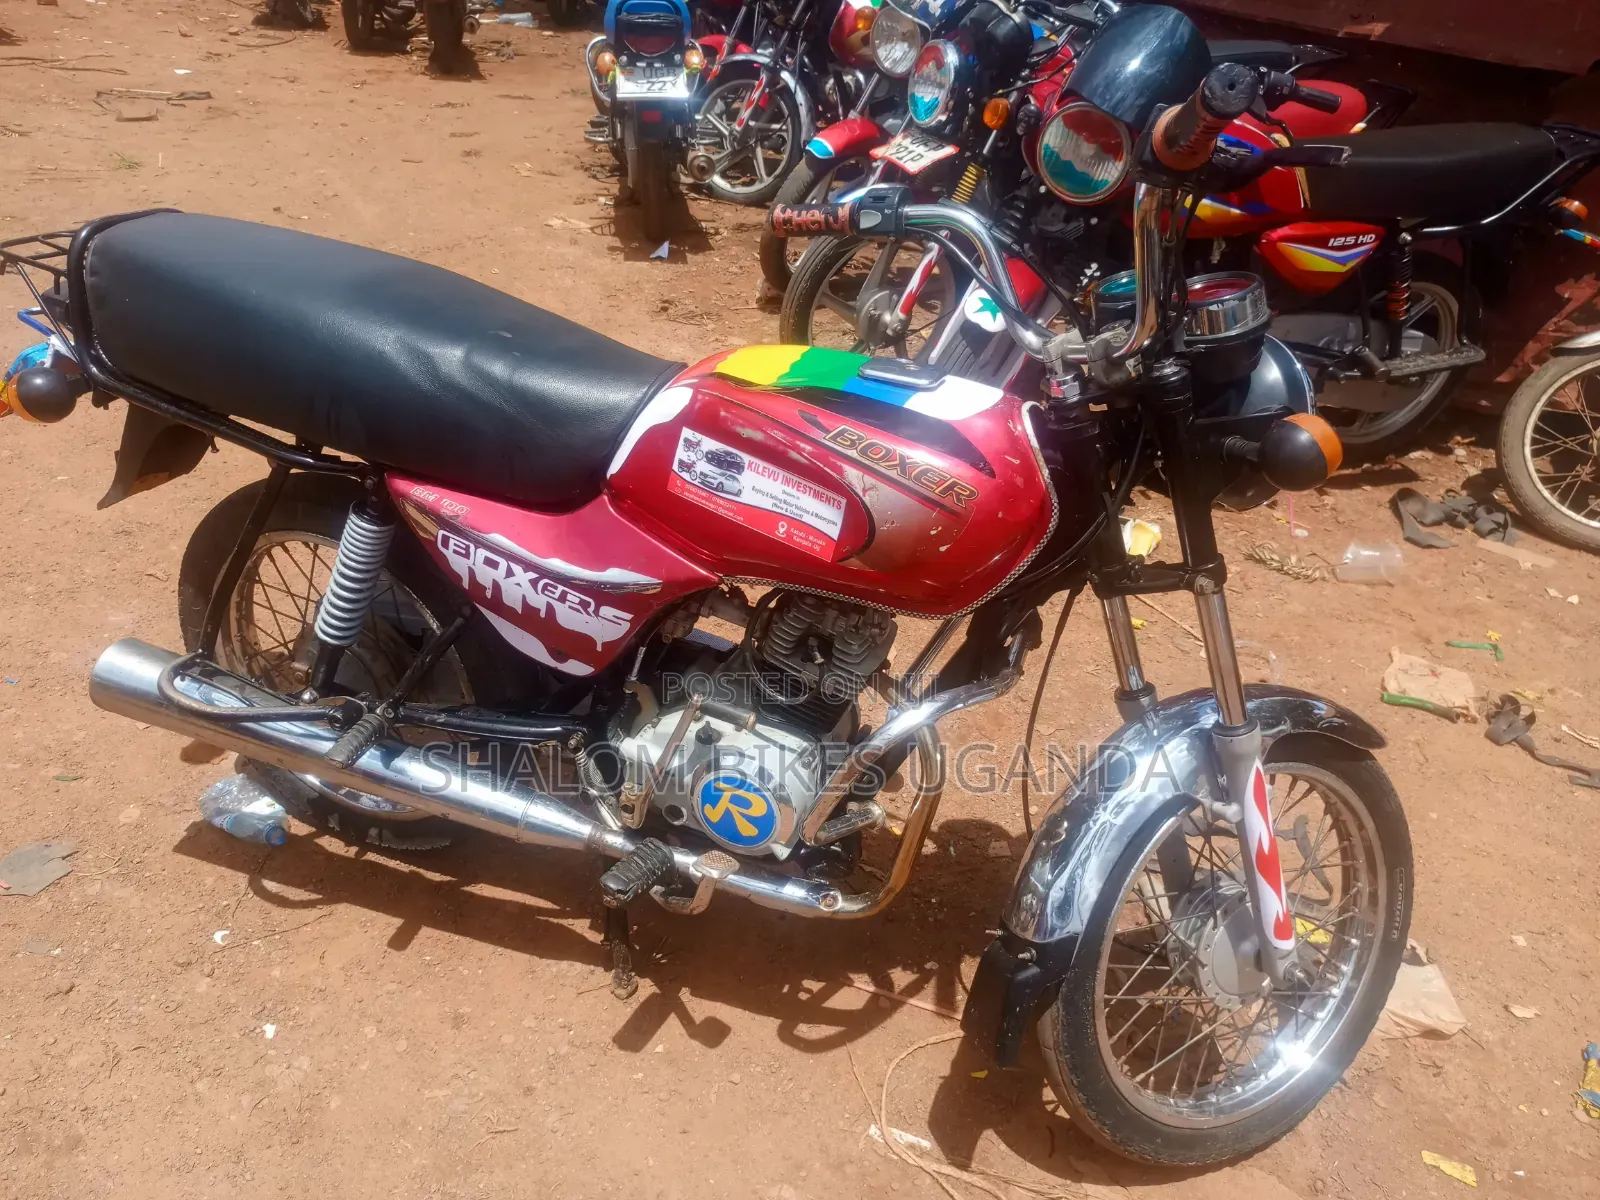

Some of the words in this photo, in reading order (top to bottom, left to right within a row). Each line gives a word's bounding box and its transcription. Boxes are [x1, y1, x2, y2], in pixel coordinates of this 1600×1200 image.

[1327, 236, 1357, 248] 125
[1357, 233, 1376, 244] HD
[746, 459, 780, 483] KILEVU
[780, 474, 842, 511] INVESTMENTS
[823, 424, 980, 509] BOXER
[409, 485, 440, 503] BM
[439, 498, 471, 516] 100
[751, 485, 766, 498] Buying
[769, 493, 783, 504] Selling
[782, 498, 796, 509] Motor
[795, 502, 811, 516] Vehicles
[814, 512, 838, 527] Motorcycles
[437, 529, 635, 652] BOXERS
[703, 781, 768, 837] R
